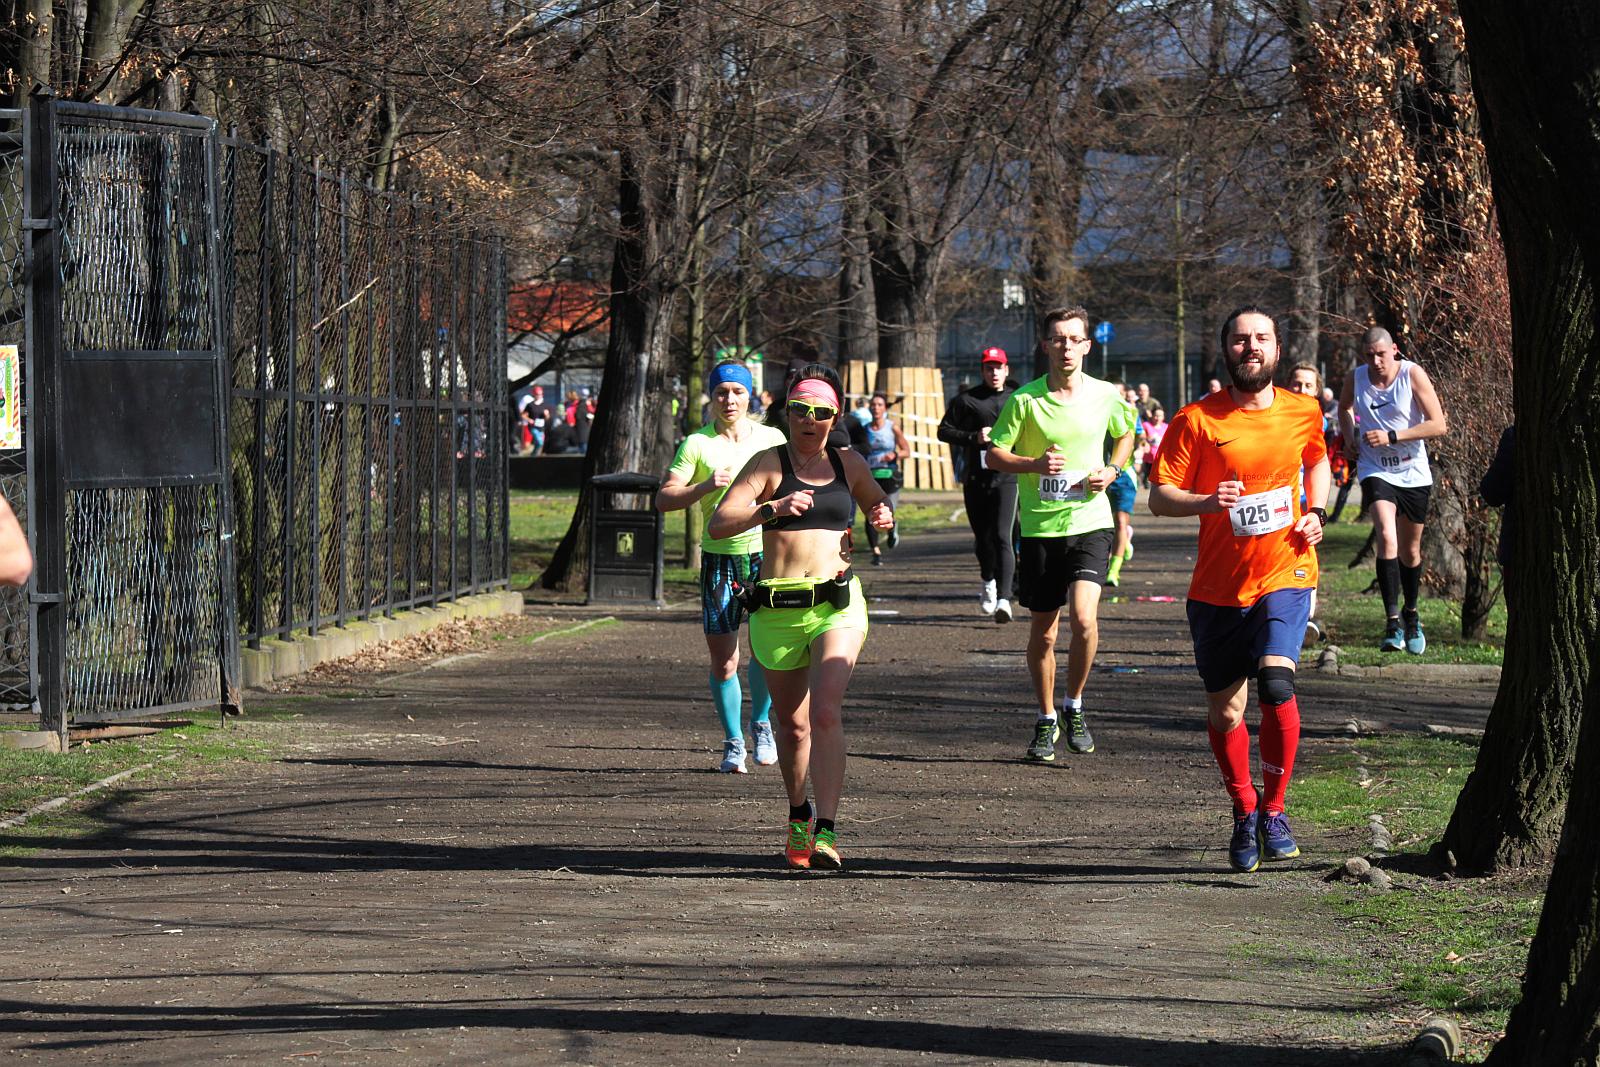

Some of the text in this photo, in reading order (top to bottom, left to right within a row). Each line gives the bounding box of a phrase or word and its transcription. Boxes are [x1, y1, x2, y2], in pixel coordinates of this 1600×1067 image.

[1381, 456, 1400, 467] 019
[1042, 478, 1067, 493] 002
[1236, 503, 1270, 527] 125
